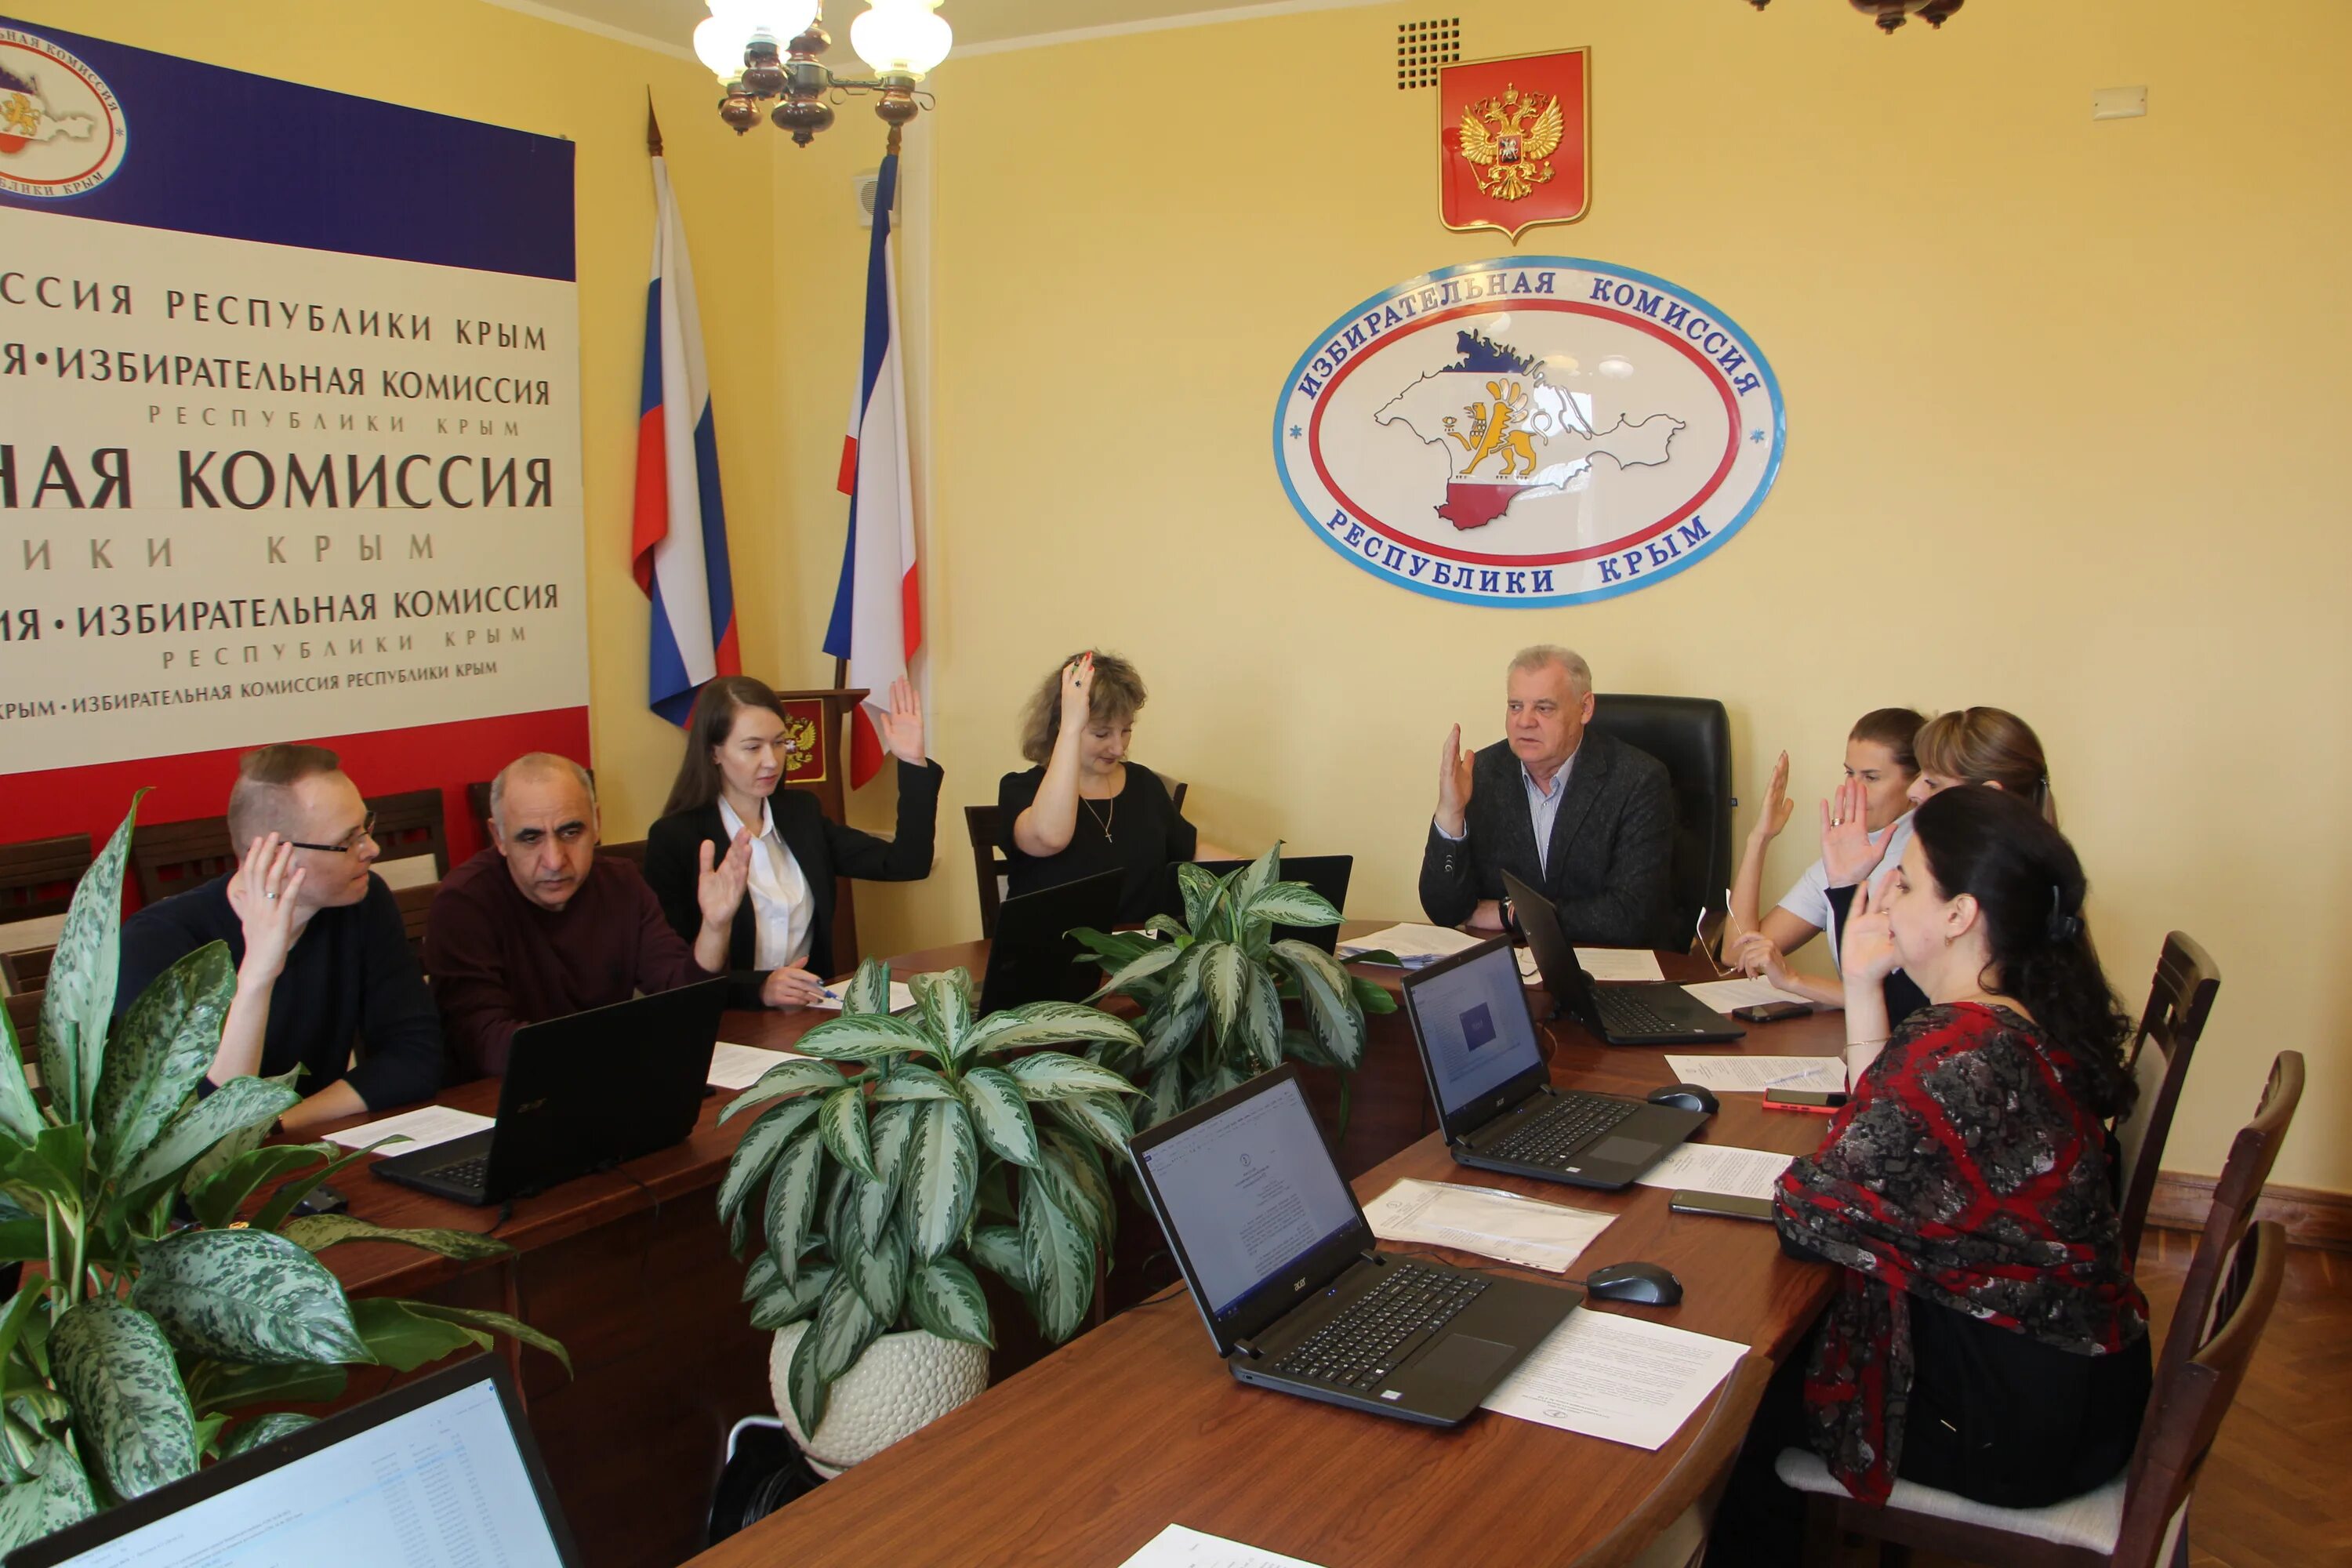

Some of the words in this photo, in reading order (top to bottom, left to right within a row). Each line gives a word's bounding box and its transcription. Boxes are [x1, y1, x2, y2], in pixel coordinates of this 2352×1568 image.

[46, 43, 118, 111] КОМИССИЯ
[63, 172, 103, 194] КРЫМ
[0, 272, 132, 314] ССИЯ
[167, 289, 430, 341] РЕСПУБЛИКИ
[456, 318, 546, 350] КРЫМ
[1298, 271, 1556, 400] ИЗБИРАТЕЛЬНАЯ
[1589, 277, 1761, 397] КОМИССИЯ
[56, 347, 364, 395] ИЗБИРАТЕЛЬНАЯ
[383, 369, 550, 405] КОМИССИЯ
[149, 405, 404, 432] РЕСПУБЛИКИ
[437, 418, 519, 436] КРЫМ
[178, 449, 553, 510] КОМИССИЯ
[267, 533, 434, 564] КРЫМ
[1327, 509, 1554, 593] РЕСПУБЛИКИ
[1598, 515, 1711, 583] КРЫМ
[77, 593, 377, 637] ИЗБИРАТЕЛЬНАЯ
[394, 583, 558, 619] КОМИССИЯ
[163, 634, 412, 669] РЕСПУБЛИКИ
[445, 626, 525, 648] КРЫМ
[72, 684, 232, 713] ИЗБИРАТЕЛЬНАЯ
[241, 675, 339, 698] КОМИССИЯ
[347, 666, 448, 688] РЕСПУБЛИКИ
[456, 662, 498, 677] КРЫМ
[1294, 1277, 1306, 1291] acer
